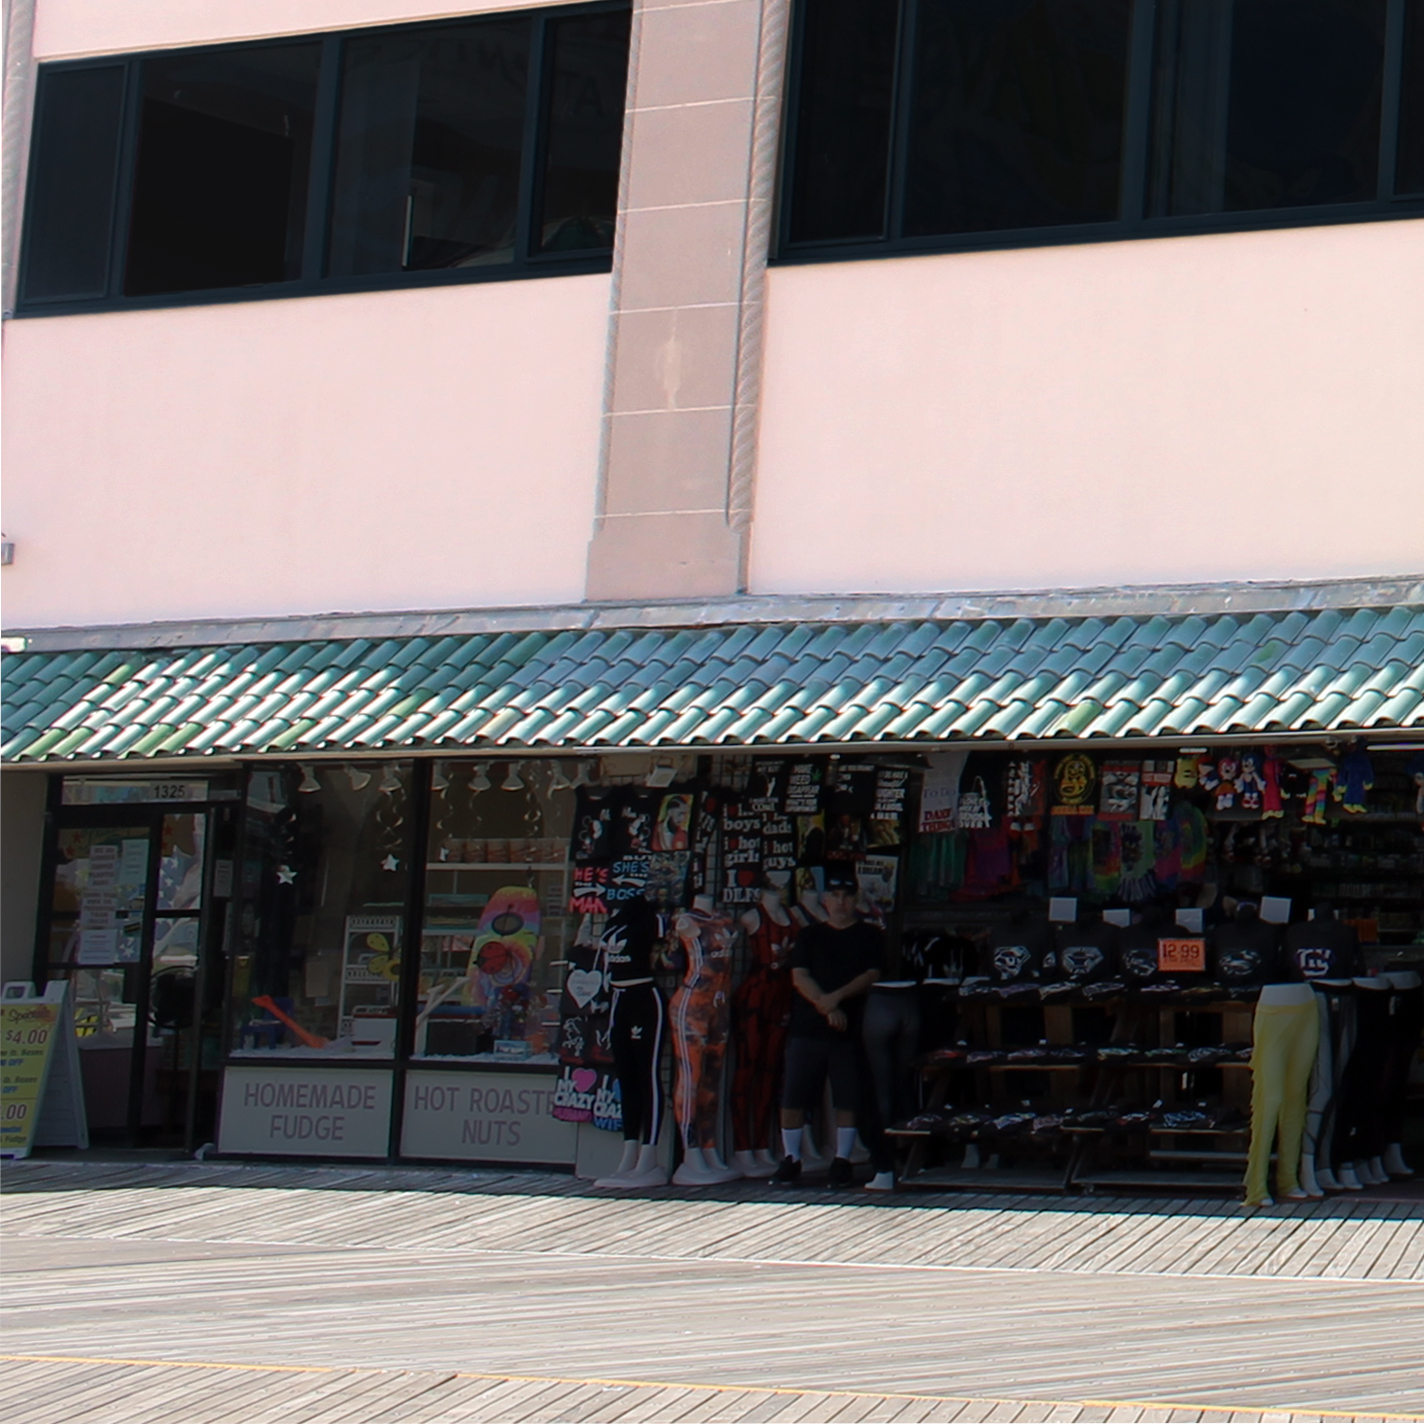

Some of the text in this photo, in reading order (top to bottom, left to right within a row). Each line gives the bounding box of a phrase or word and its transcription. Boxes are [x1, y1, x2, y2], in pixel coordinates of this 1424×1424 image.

[154, 784, 186, 799] 1325
[723, 819, 760, 832] boys
[573, 867, 609, 883] HE'S
[612, 861, 650, 874] SHE'S
[727, 870, 736, 887] I
[6, 1029, 48, 1044] $4.00
[557, 1079, 577, 1093] MY
[244, 1083, 376, 1110] HOMEMADE
[414, 1086, 556, 1116] HOT ROASTE
[554, 1091, 594, 1109] CRAZY
[269, 1114, 345, 1141] FUDGE
[594, 1118, 622, 1130] WIF
[462, 1119, 522, 1146] NUTS
